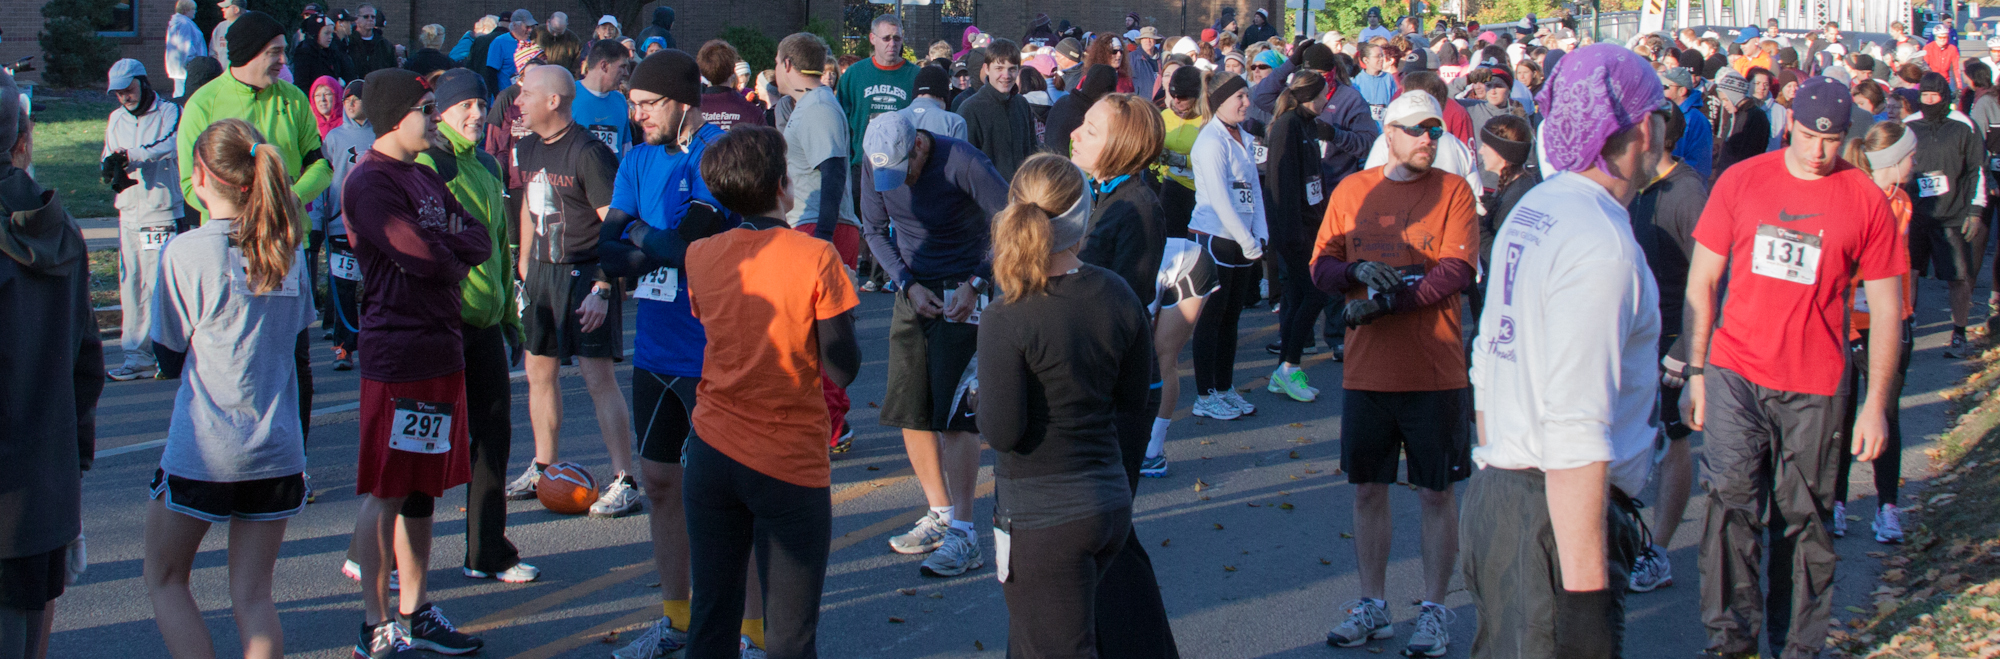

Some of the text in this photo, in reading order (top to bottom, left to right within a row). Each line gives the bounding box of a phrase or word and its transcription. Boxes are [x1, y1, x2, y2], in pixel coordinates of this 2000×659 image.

[864, 84, 907, 100] EAGLES
[1920, 177, 1941, 190] 327
[146, 232, 171, 244] 147
[1765, 239, 1806, 267] 131
[402, 413, 443, 438] 297
